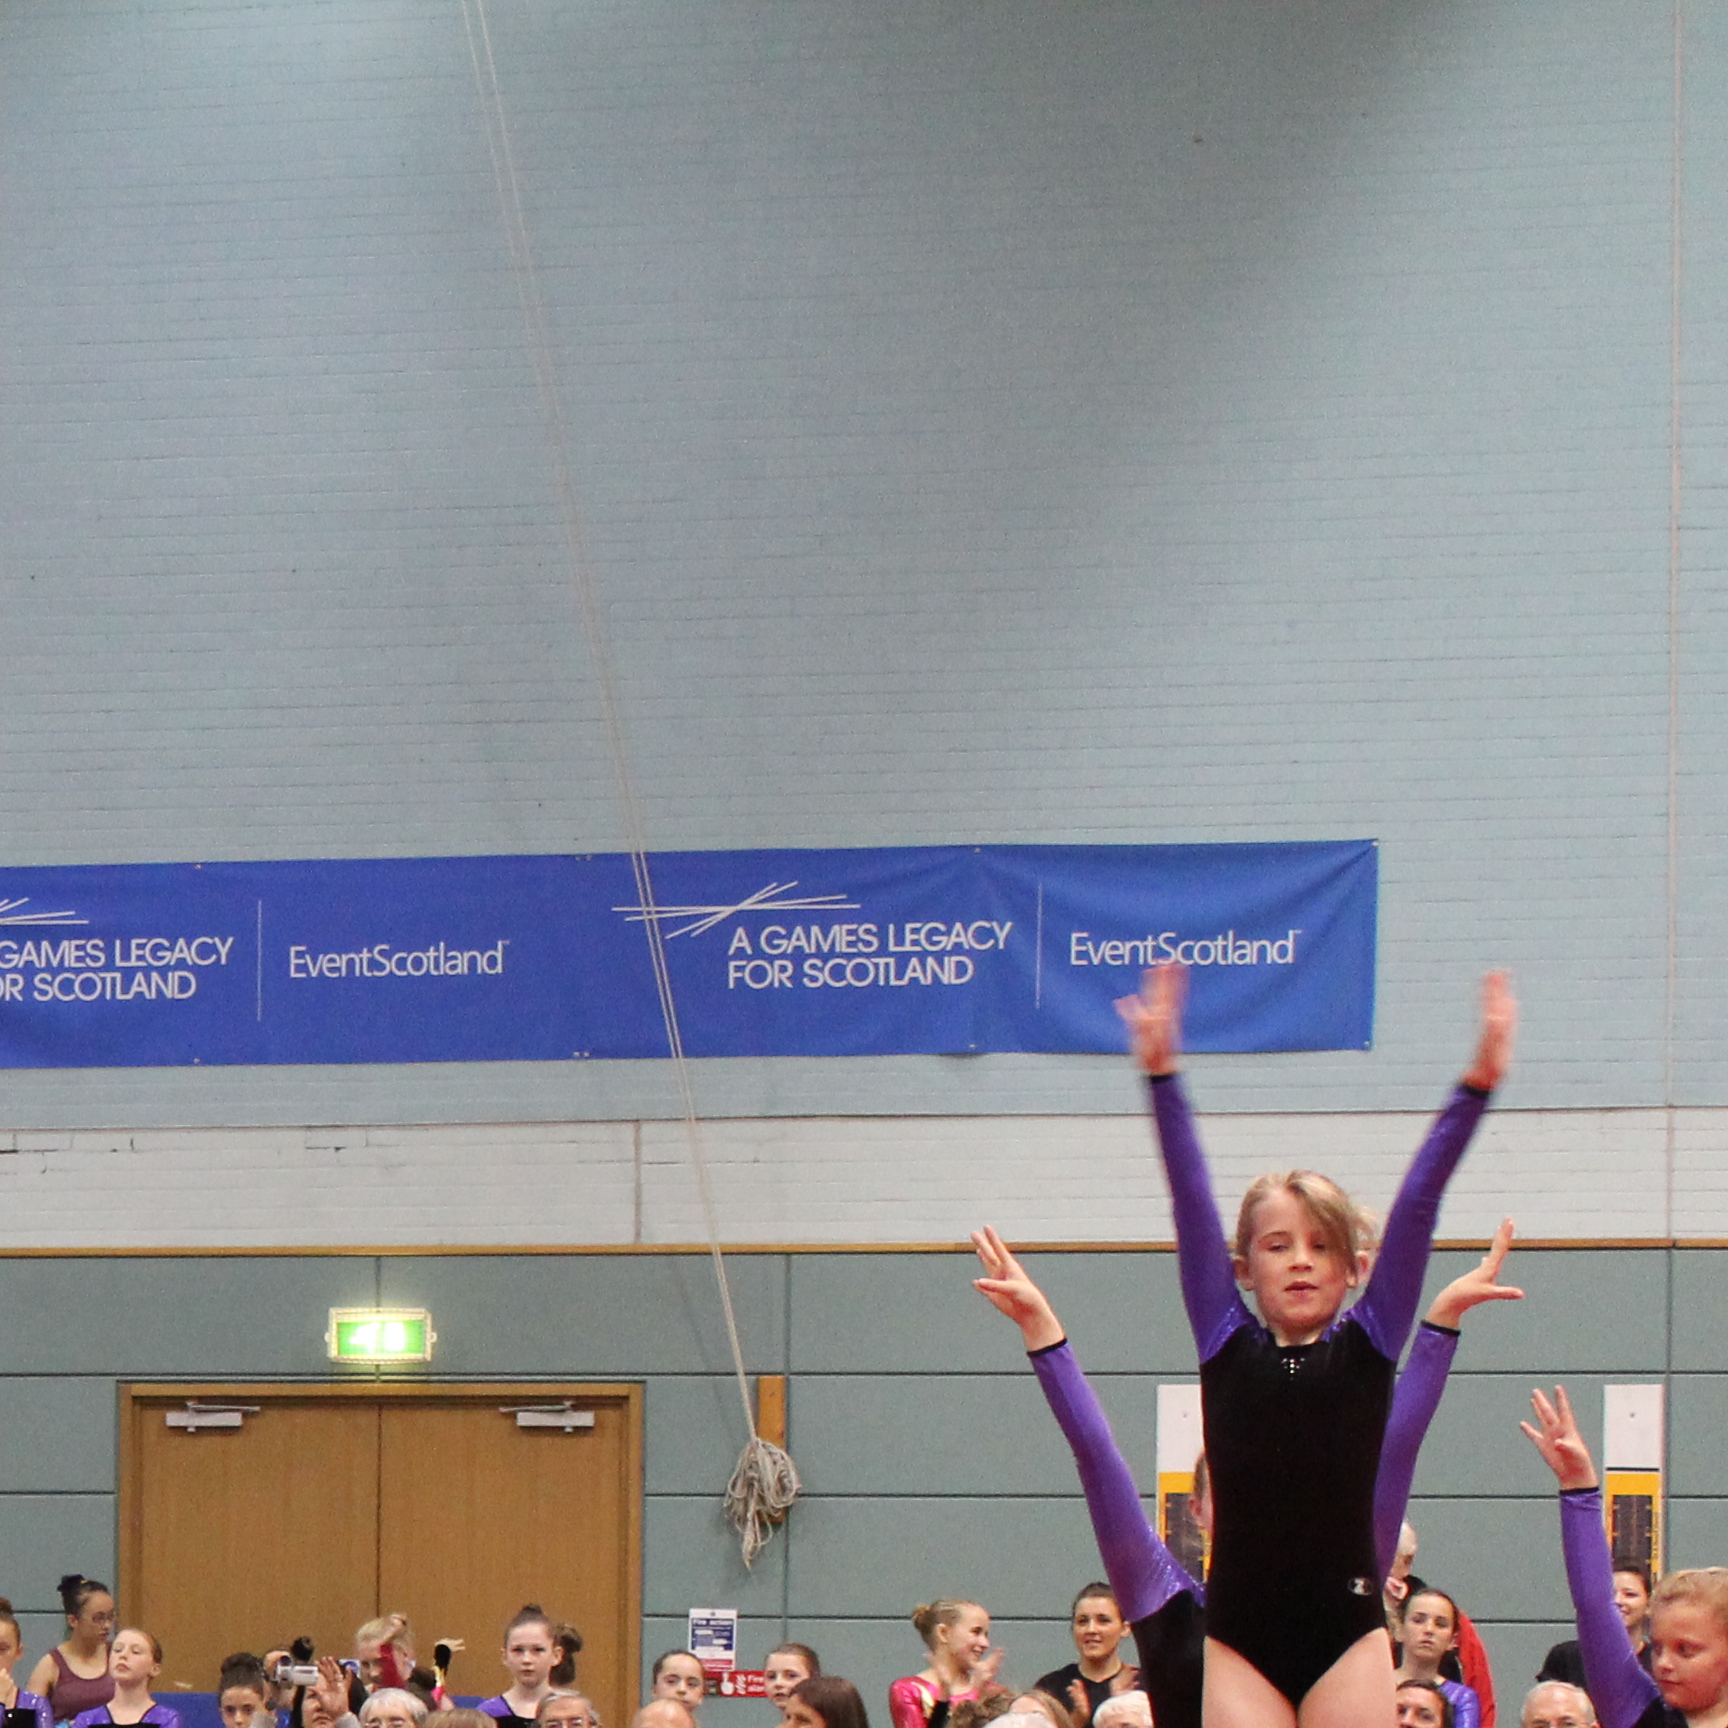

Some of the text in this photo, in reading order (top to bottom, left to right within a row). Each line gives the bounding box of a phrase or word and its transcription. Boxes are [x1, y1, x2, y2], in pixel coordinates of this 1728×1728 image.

[114, 936, 234, 968] LEGACY
[728, 921, 1013, 956] A GAMES LEGACY
[1070, 930, 1295, 966] EventScotland
[289, 940, 504, 978] EventScotland
[728, 956, 975, 990] FOR SCOTLAND
[33, 971, 197, 1001] SCOTLAND
